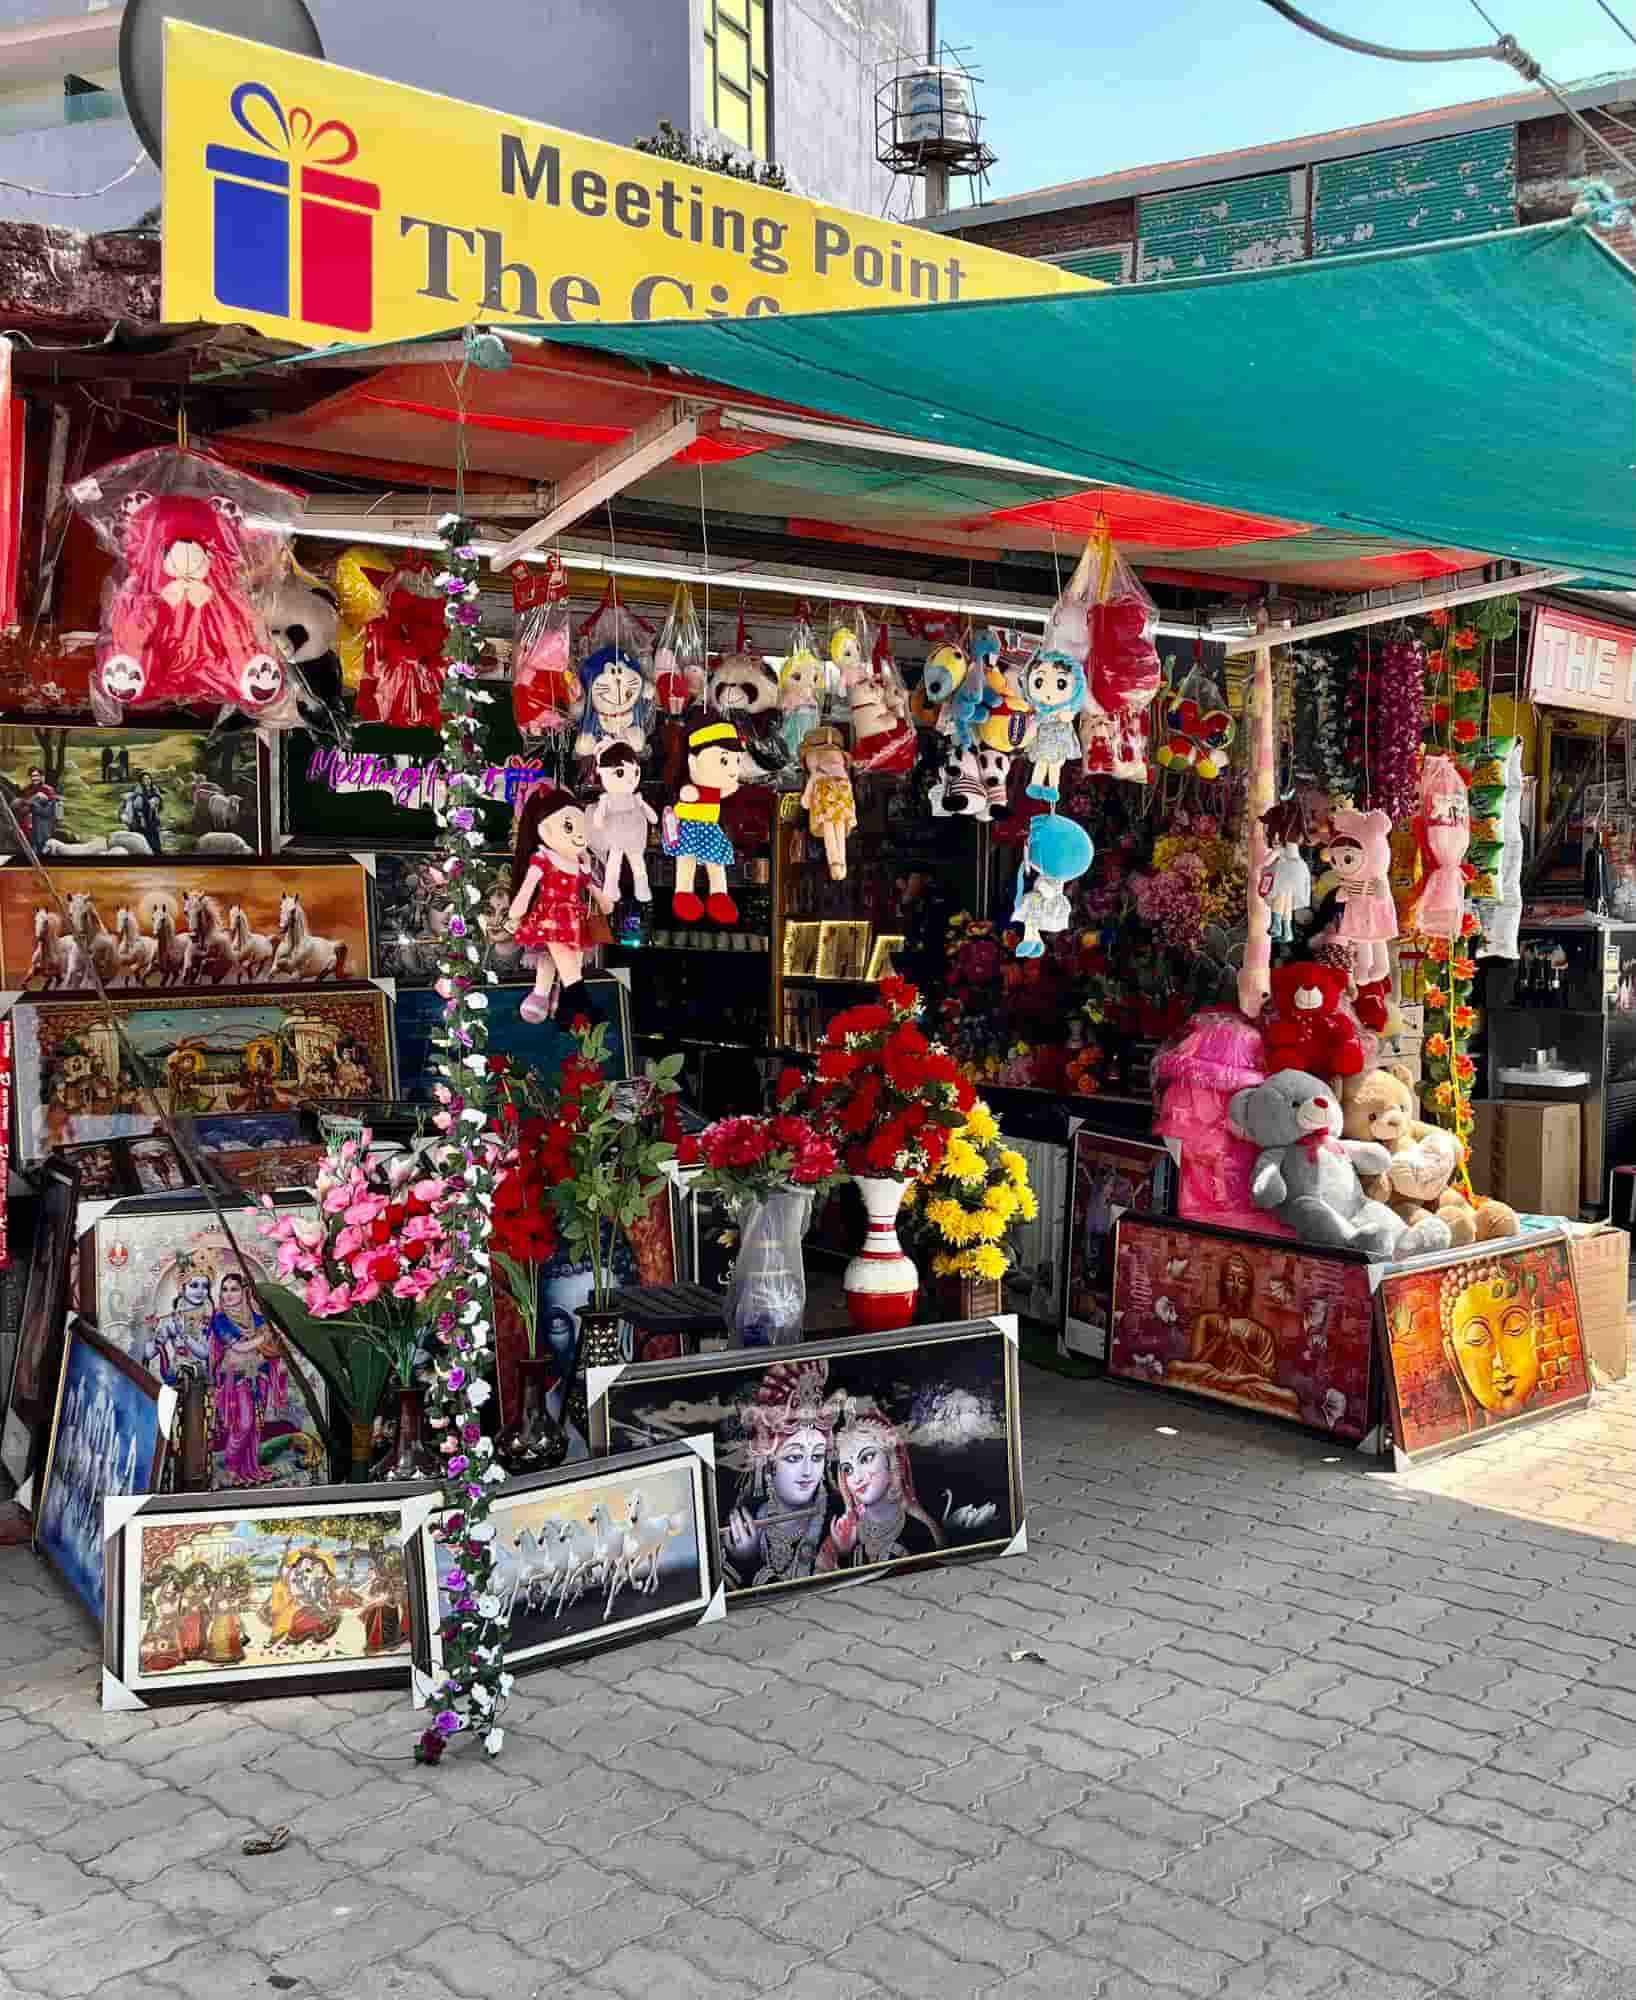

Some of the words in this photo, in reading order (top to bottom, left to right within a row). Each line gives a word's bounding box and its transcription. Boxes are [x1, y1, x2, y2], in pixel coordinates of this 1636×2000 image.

[400, 215, 600, 321] The
[501, 133, 789, 274] Meeting
[815, 218, 966, 300] Point
[1542, 625, 1618, 699] THE
